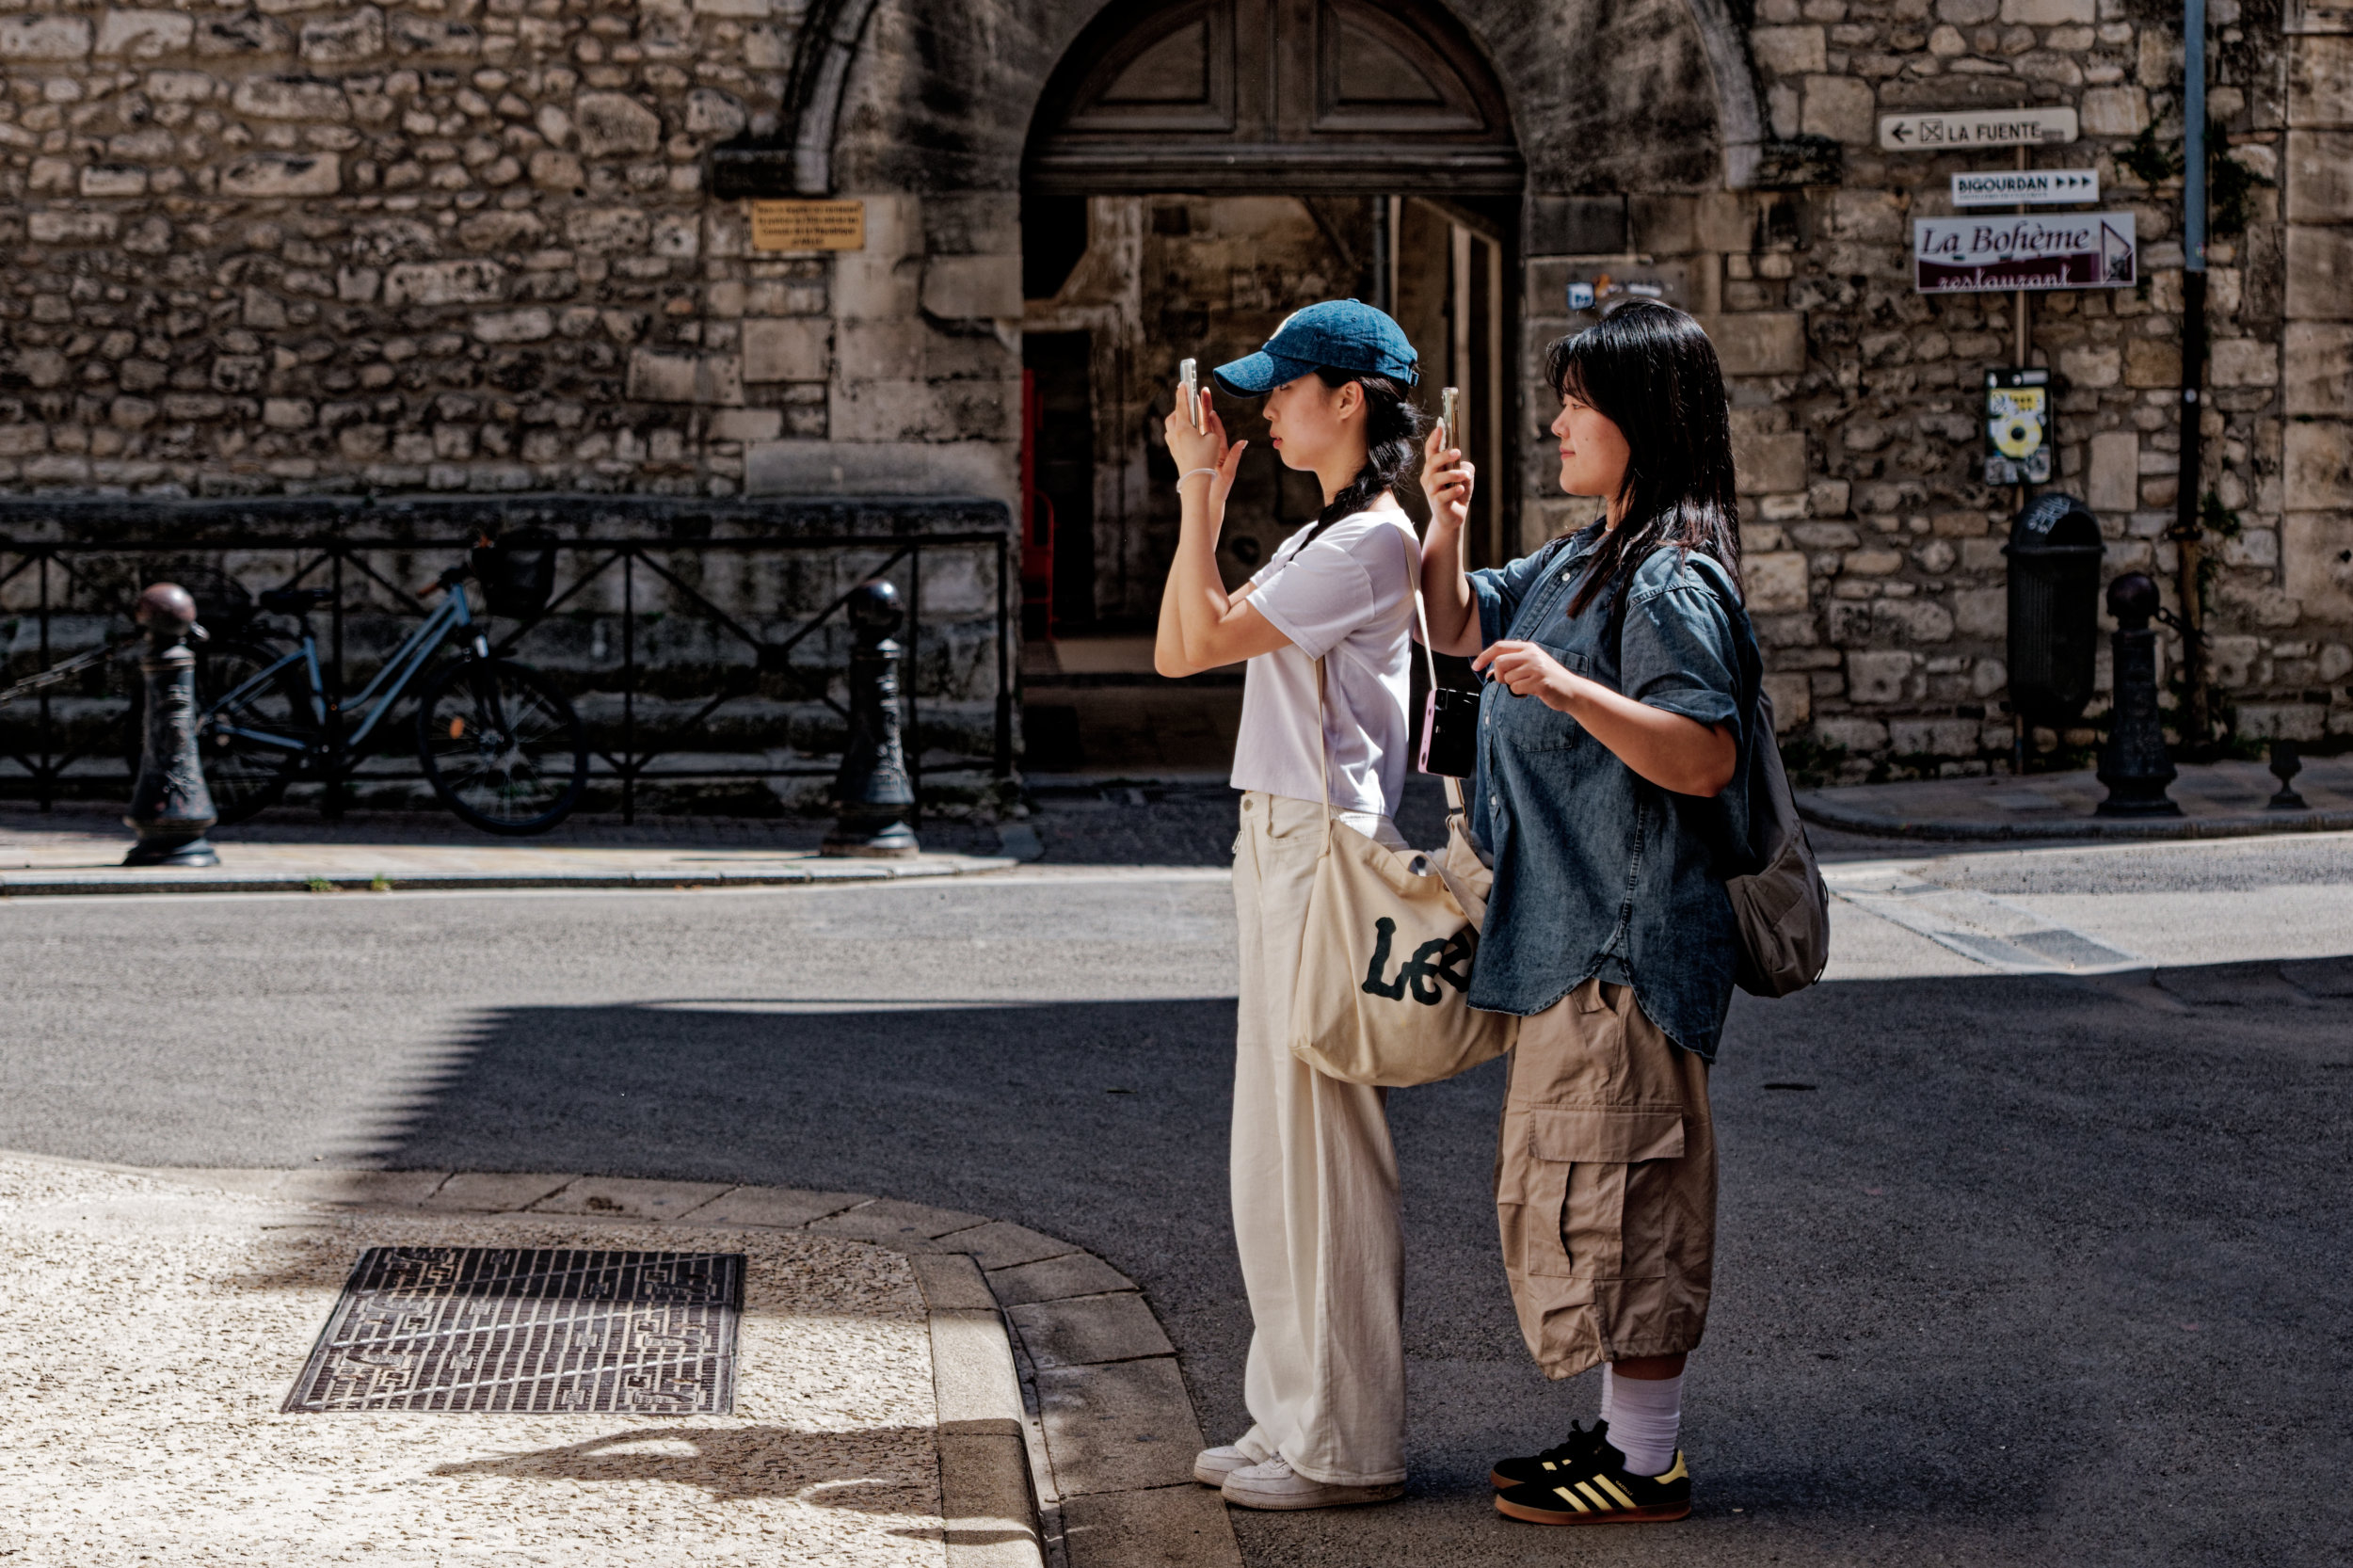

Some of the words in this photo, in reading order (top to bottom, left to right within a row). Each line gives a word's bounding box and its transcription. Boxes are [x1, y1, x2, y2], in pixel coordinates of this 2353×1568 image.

[1948, 125, 1969, 142] LA
[1977, 120, 2041, 141] FUENTE
[1958, 175, 2049, 193] BIGOURDAN
[1921, 226, 1961, 254] La
[1971, 220, 2090, 253] Bohème
[1938, 263, 2073, 289] restaurant
